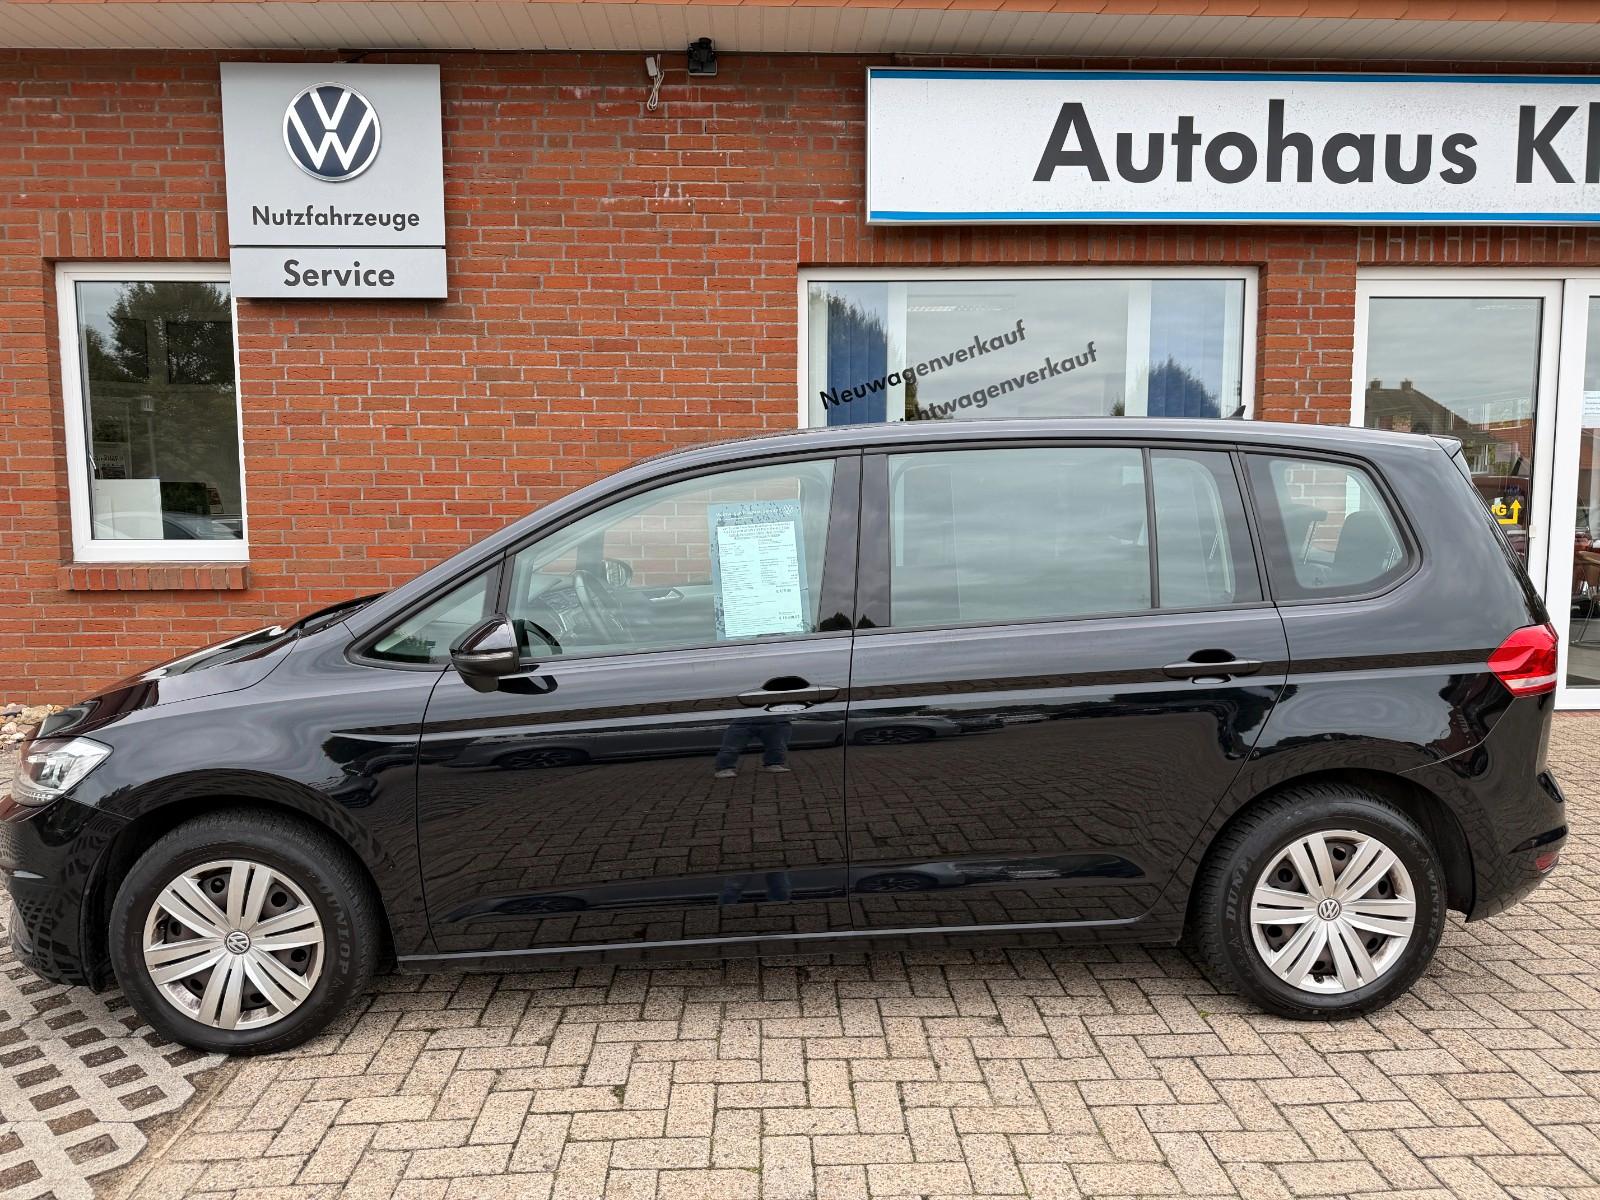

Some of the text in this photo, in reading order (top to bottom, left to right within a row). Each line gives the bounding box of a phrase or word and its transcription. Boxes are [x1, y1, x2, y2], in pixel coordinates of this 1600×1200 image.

[285, 86, 378, 176] VW
[1033, 99, 1478, 184] Autohaus
[252, 205, 420, 231] Nutzfahrzeuge
[283, 259, 395, 287] Service
[819, 319, 1026, 410] Neuwagenverkauf
[910, 341, 1097, 421] htwagenverkauf
